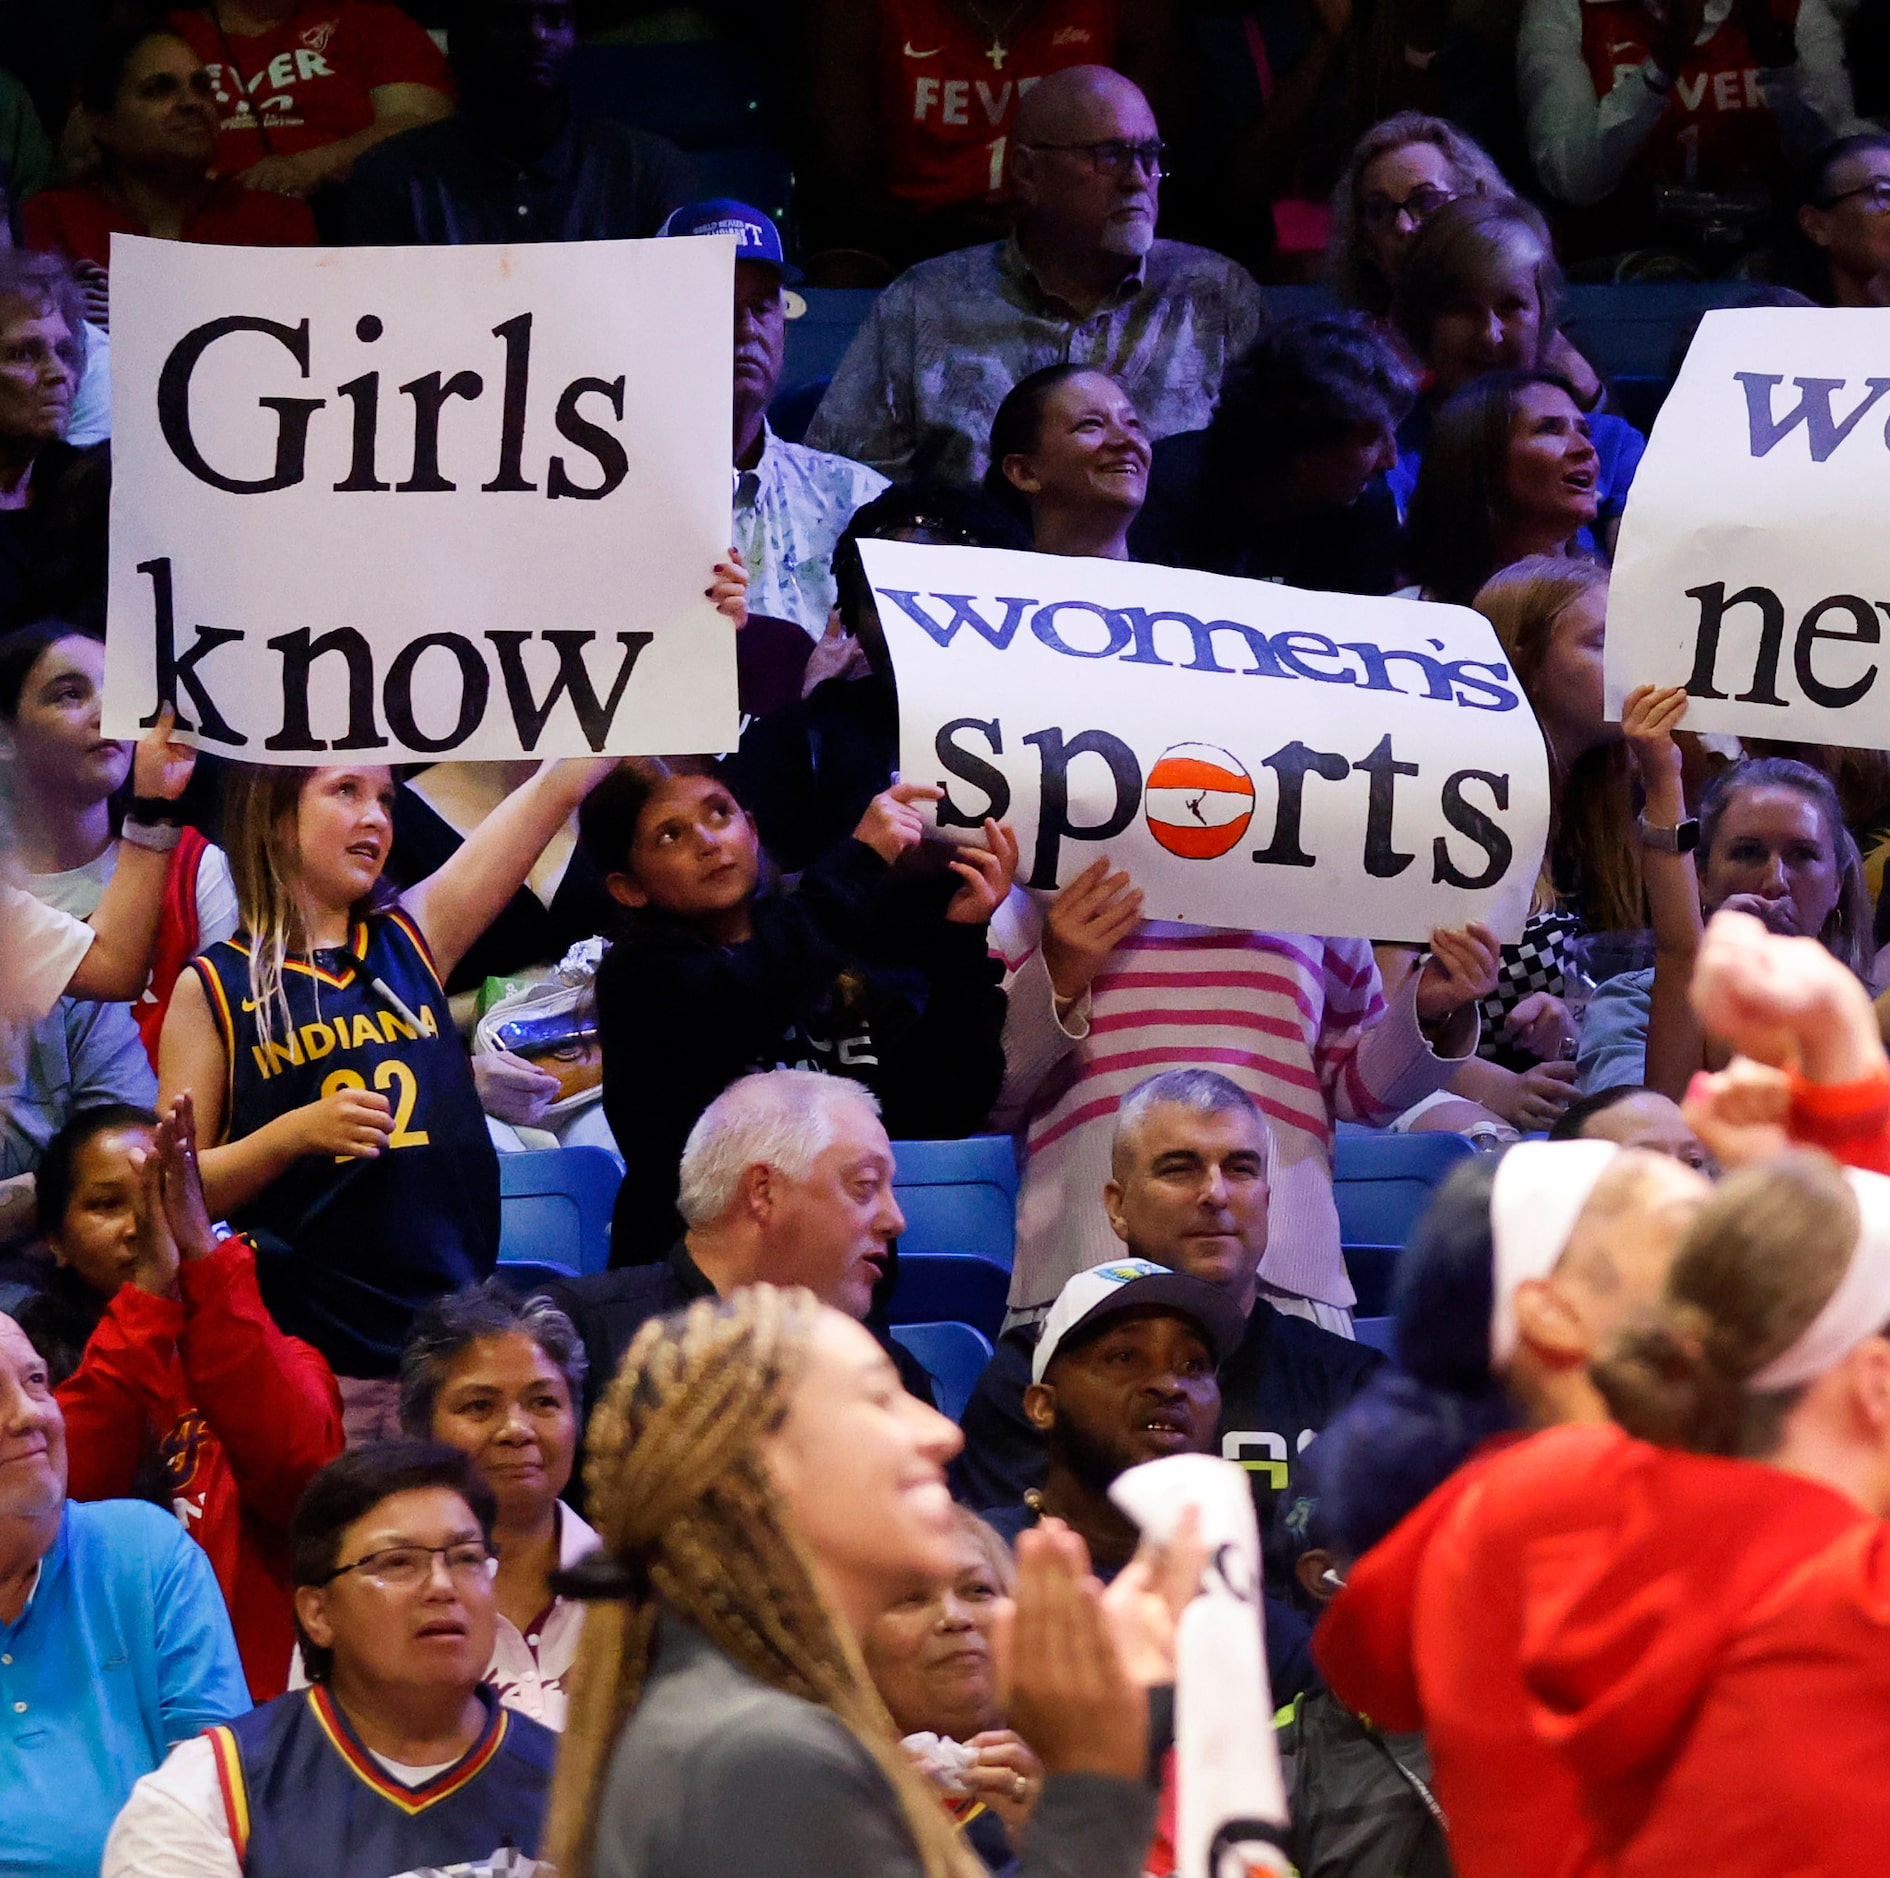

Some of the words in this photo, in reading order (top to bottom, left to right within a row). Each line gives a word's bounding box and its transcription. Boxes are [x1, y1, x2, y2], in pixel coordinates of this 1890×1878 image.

[986, 136, 1007, 190] 1
[157, 312, 630, 501] Girls
[136, 556, 654, 754] know
[875, 588, 1520, 712] women's
[935, 717, 1513, 890] sports
[251, 1004, 440, 1081] INDIANA
